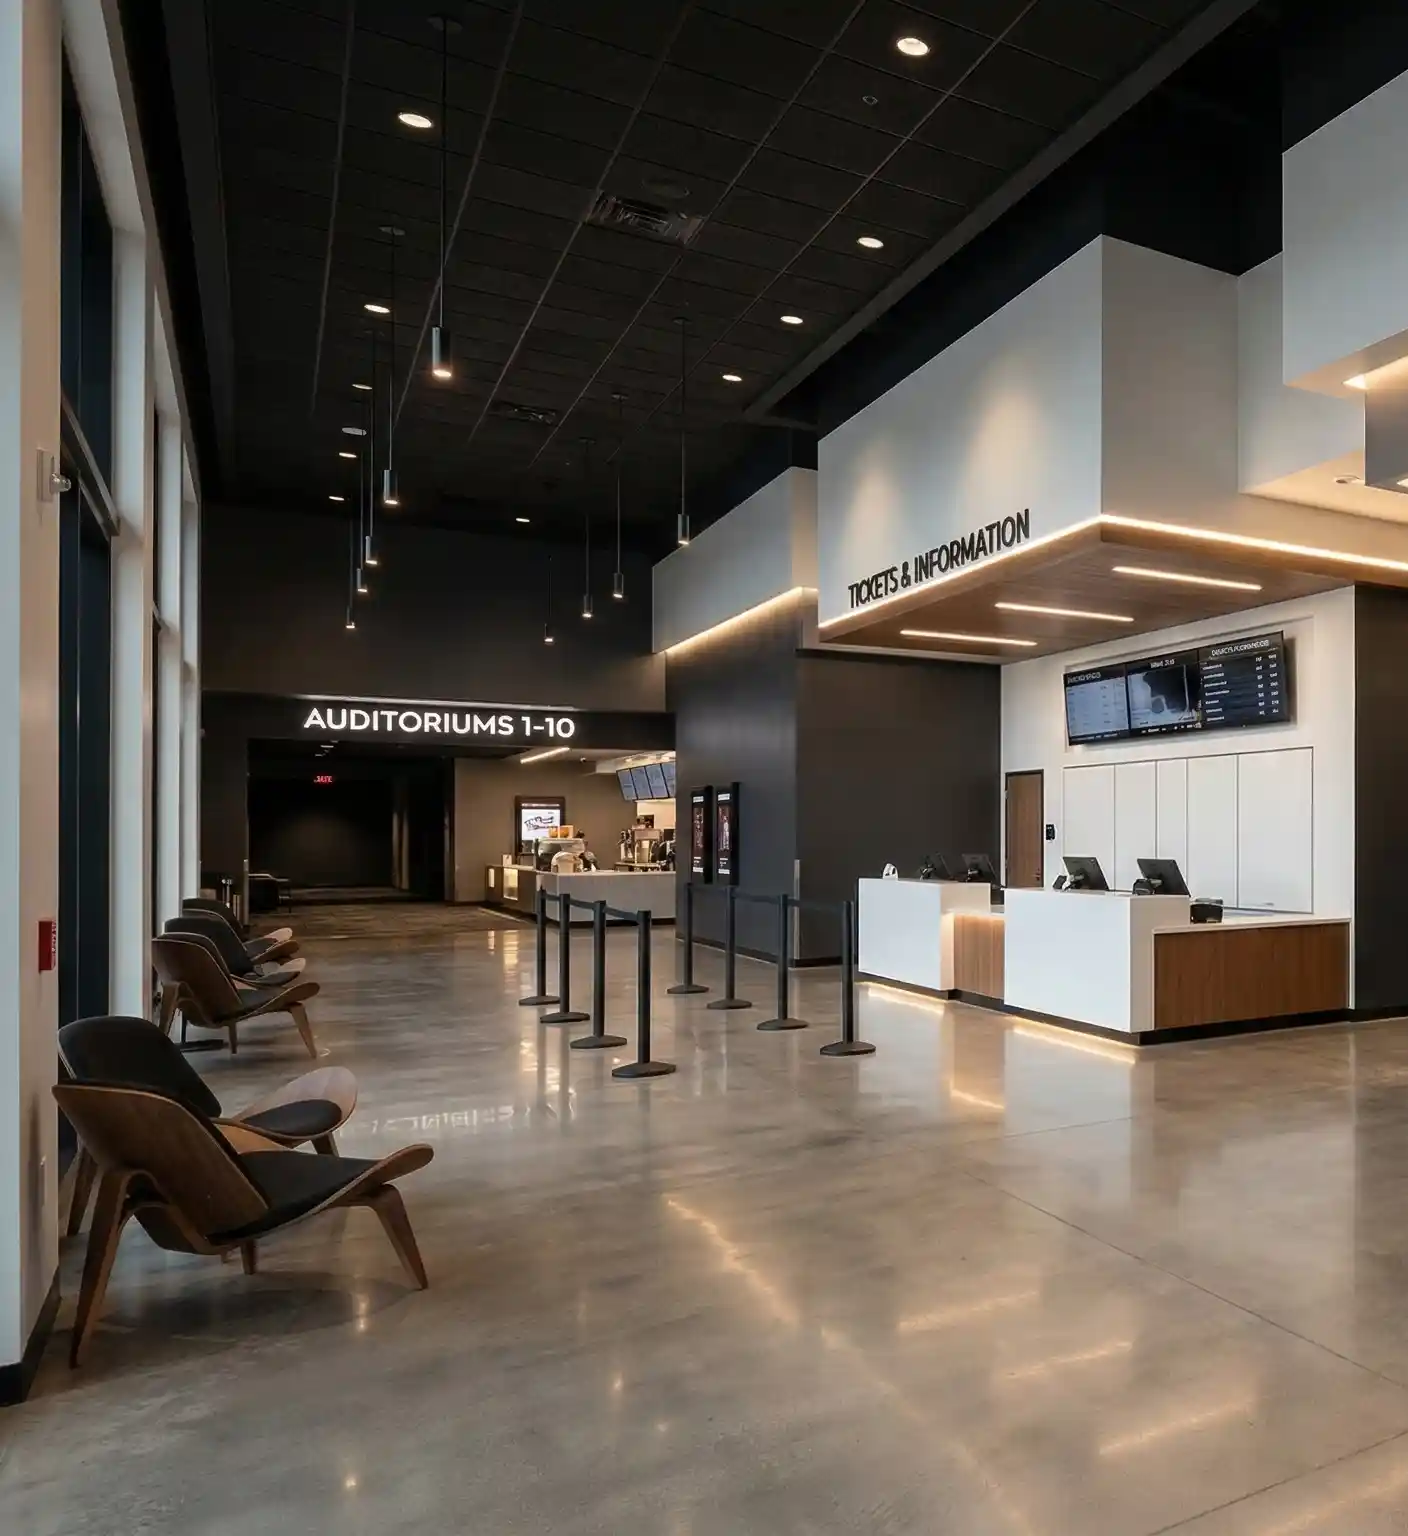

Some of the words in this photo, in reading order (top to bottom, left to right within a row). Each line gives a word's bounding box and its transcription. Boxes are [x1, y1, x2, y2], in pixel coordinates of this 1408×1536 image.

[848, 566, 898, 609] TICKETS
[901, 561, 911, 589] &
[914, 508, 1030, 584] INFORMATION
[303, 707, 514, 736] AUDITORIUMS
[520, 716, 576, 738] 1-10
